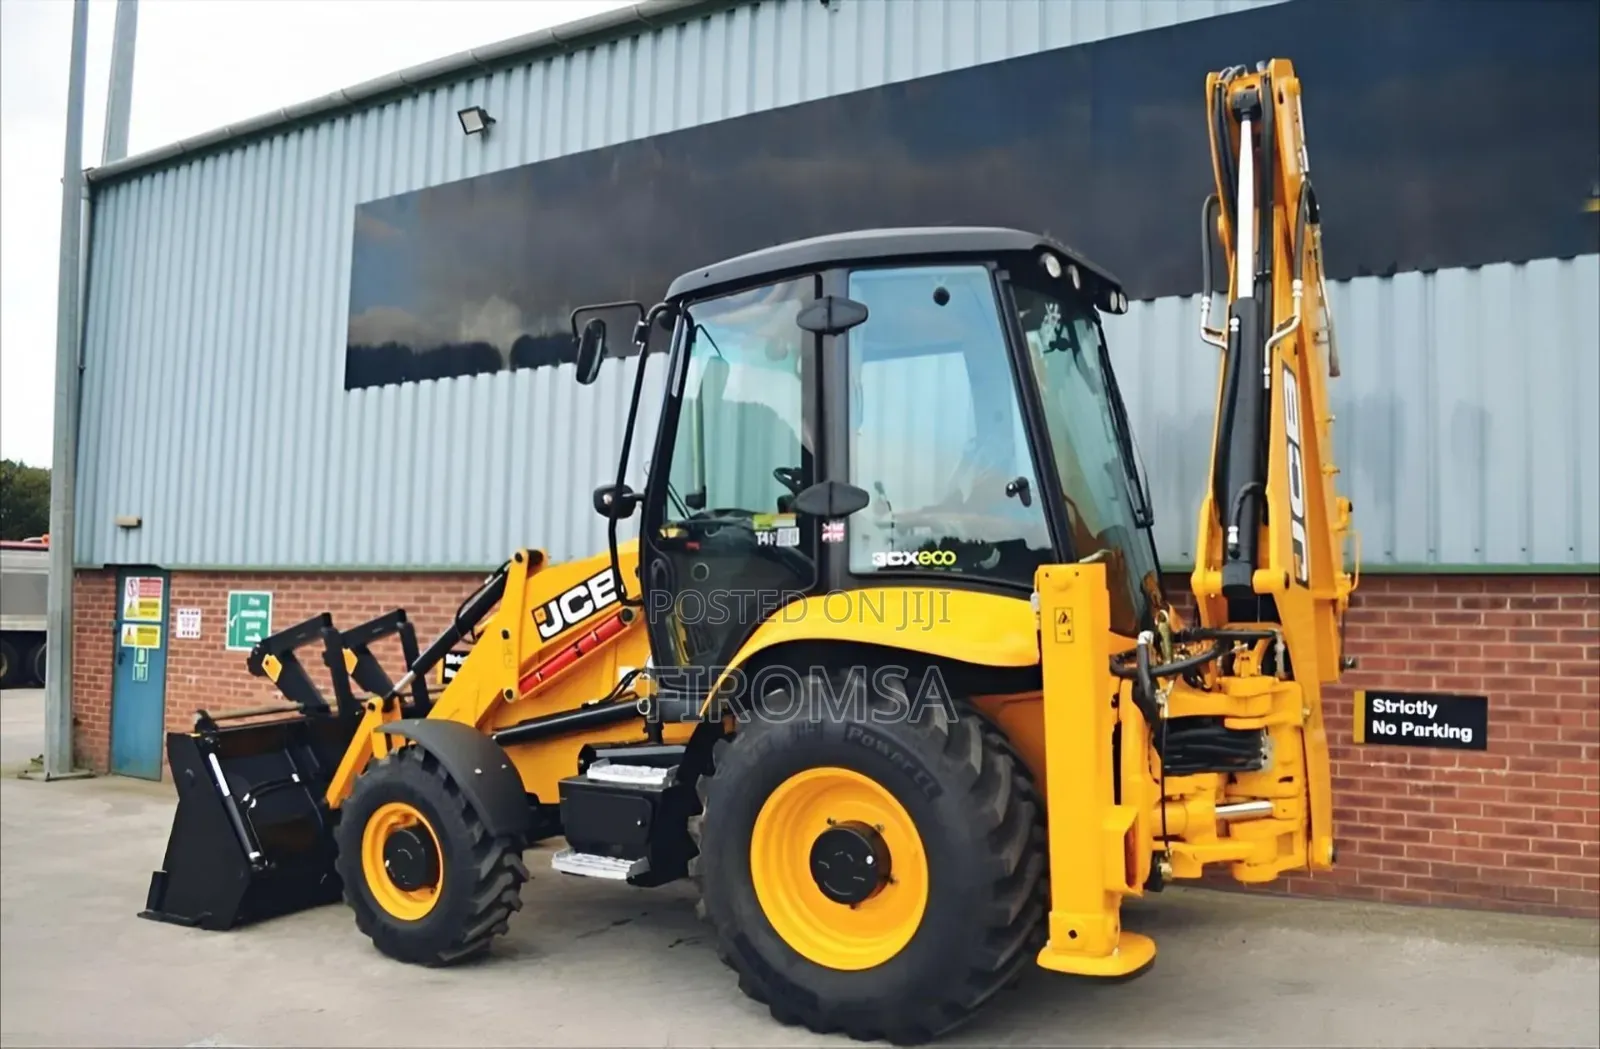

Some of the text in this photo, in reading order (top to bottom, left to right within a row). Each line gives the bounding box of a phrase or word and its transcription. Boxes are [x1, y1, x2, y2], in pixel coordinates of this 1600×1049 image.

[1283, 368, 1308, 583] JCB
[538, 568, 618, 638] JCB
[1372, 698, 1438, 719] Strictly
[1372, 720, 1473, 743] No Parking
